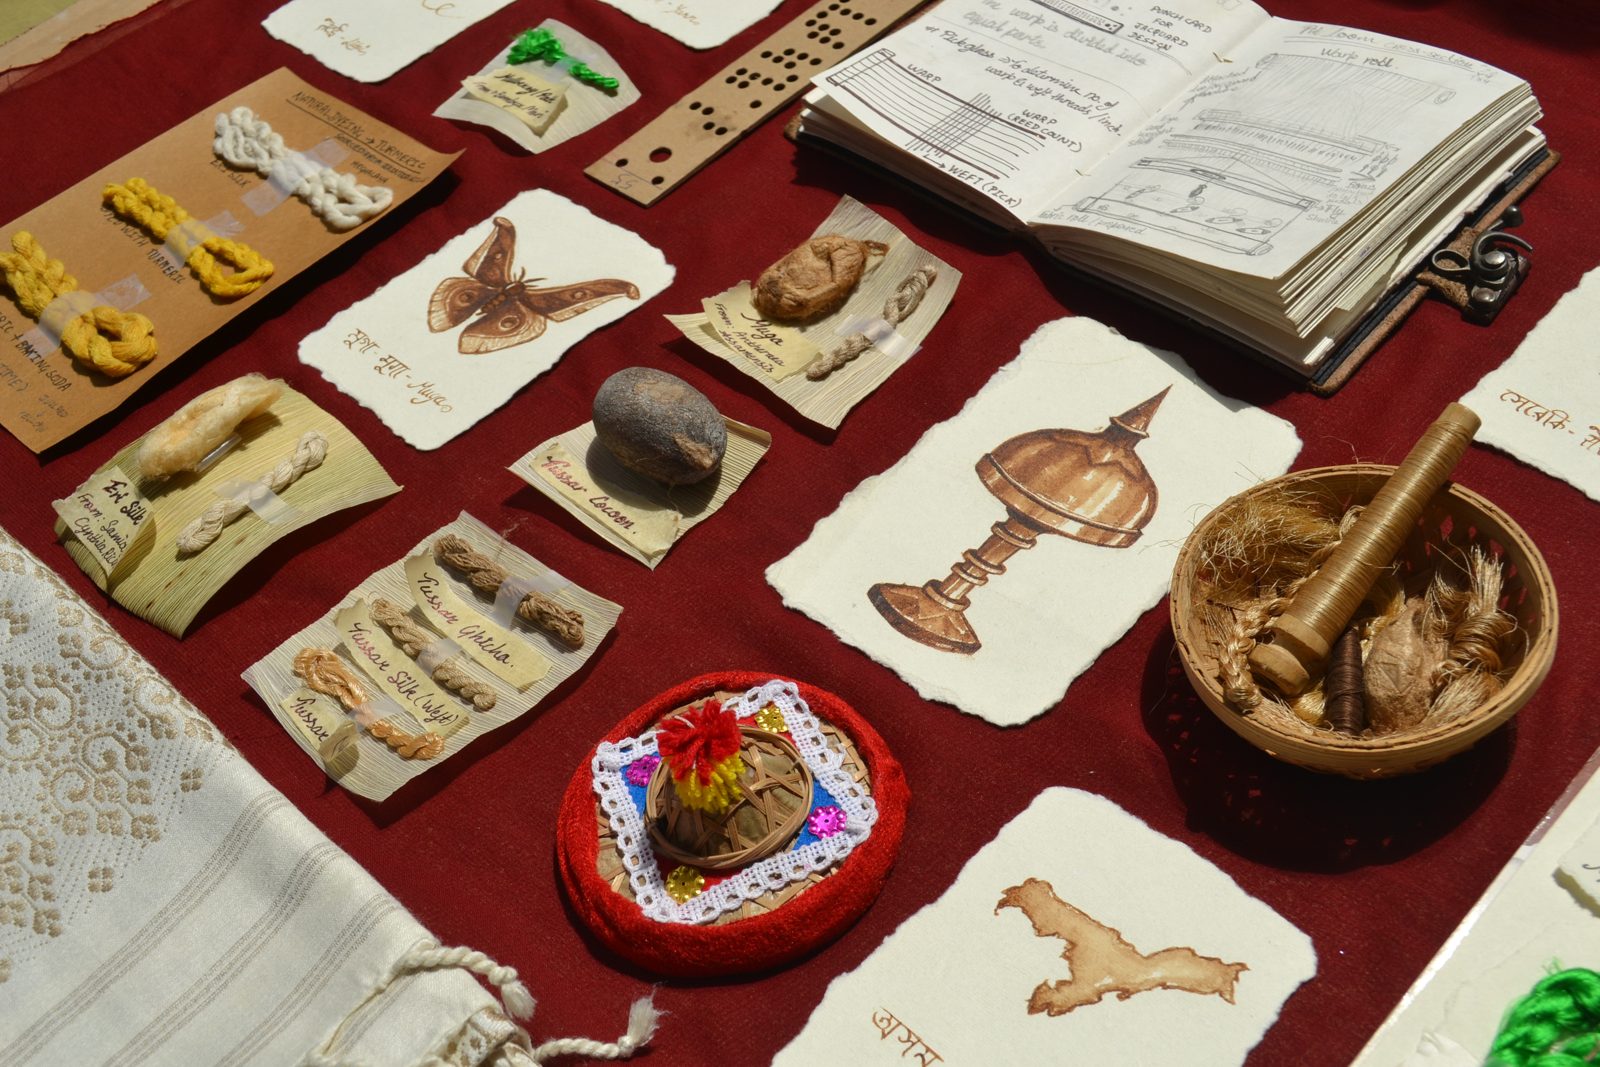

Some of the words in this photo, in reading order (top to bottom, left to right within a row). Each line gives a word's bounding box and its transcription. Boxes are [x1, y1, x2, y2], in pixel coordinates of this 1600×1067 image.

[1134, 22, 1189, 47] JACQUARD
[1150, 5, 1184, 21] PUNCH
[1185, 18, 1212, 34] CARD
[1152, 18, 1173, 28] FOR
[1128, 32, 1172, 51] DESIGN
[907, 63, 942, 83] WARP
[1007, 113, 1040, 130] (REED
[1040, 128, 1082, 153] COUNT)
[1022, 109, 1058, 125] WARP
[375, 139, 427, 170] TURMERIC
[948, 164, 984, 185] WEFT
[981, 181, 1022, 209] (PICK)
[147, 248, 186, 285] TURMERIC
[741, 312, 784, 347] Muga
[15, 340, 51, 374] BAKING
[45, 369, 73, 392] SODA
[102, 479, 129, 504] Eri
[120, 500, 147, 526] Silk
[74, 517, 107, 555] Cynthia
[100, 519, 129, 553] Samia
[417, 571, 459, 625] Tussar
[348, 620, 388, 673] Tussar
[387, 670, 415, 701] Silk
